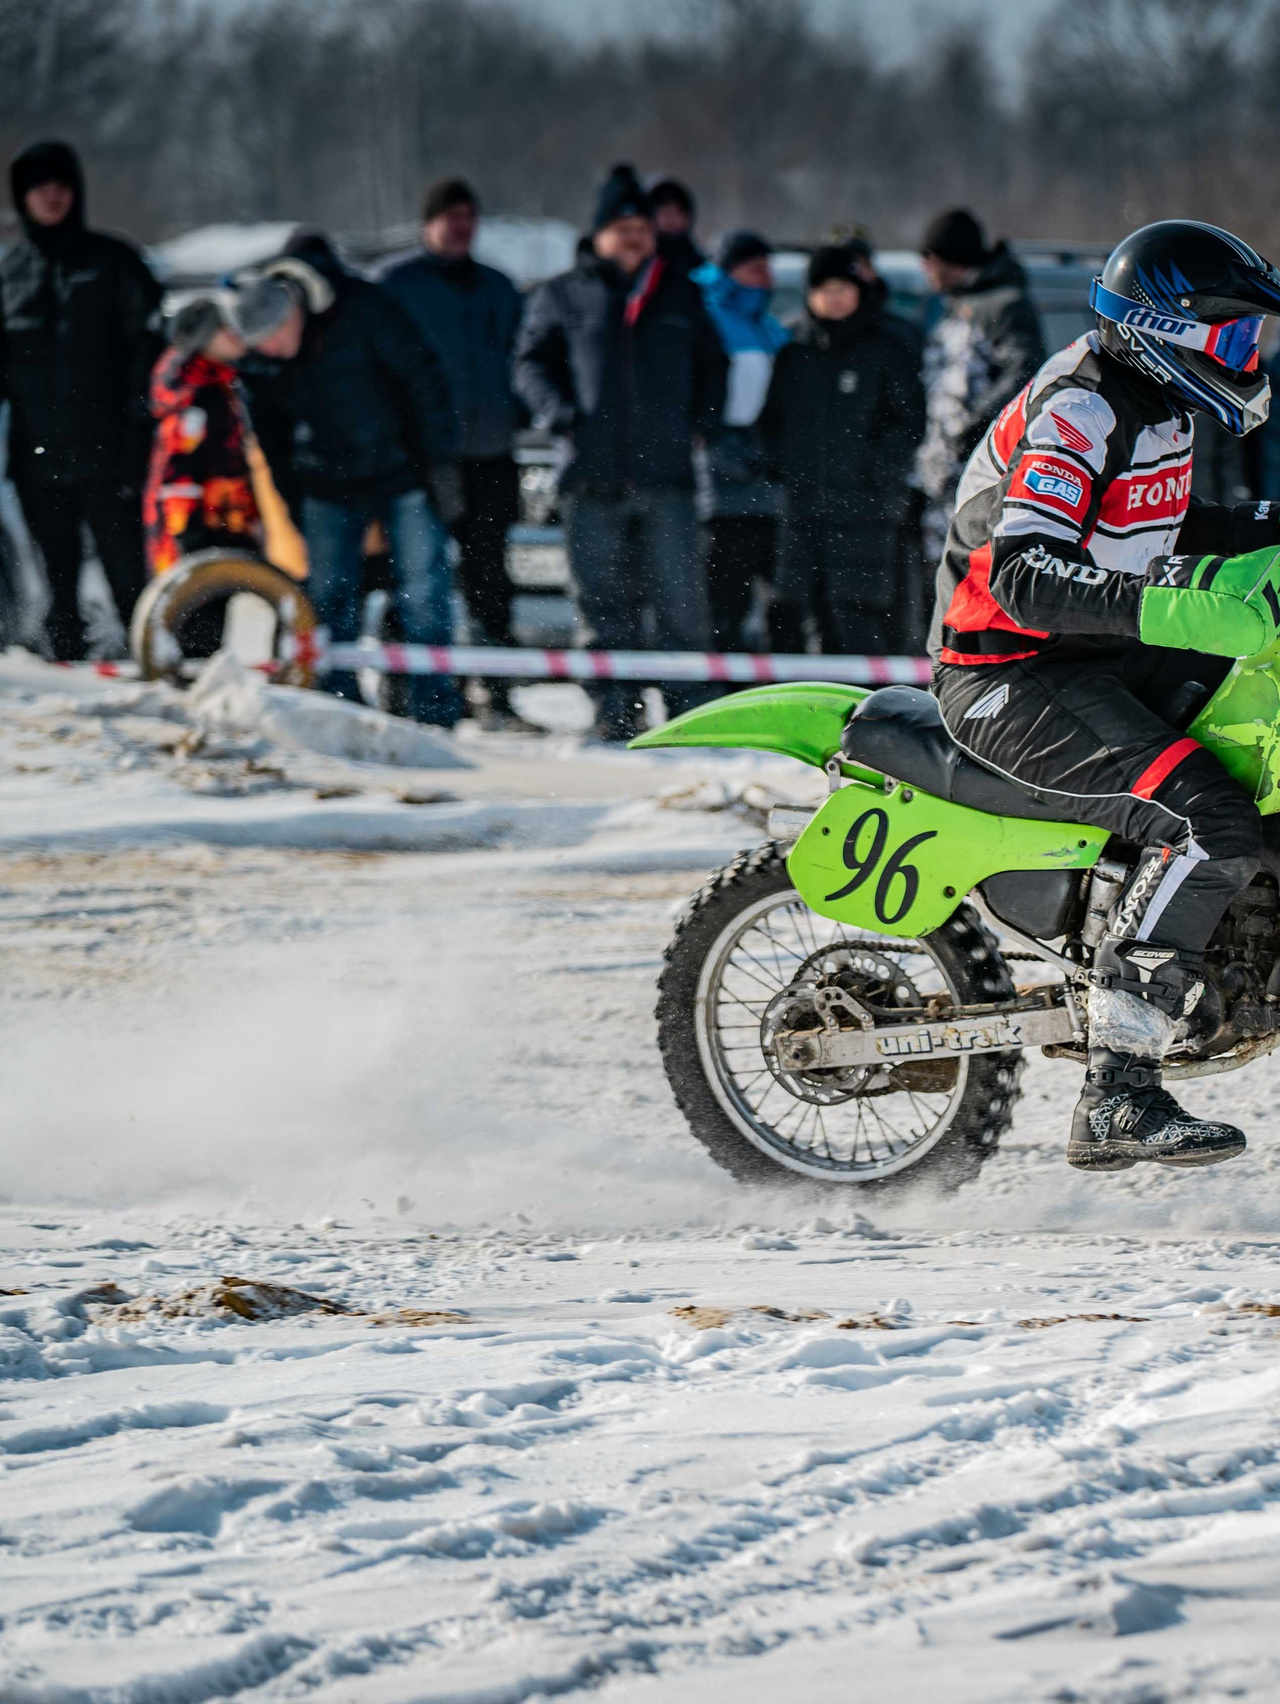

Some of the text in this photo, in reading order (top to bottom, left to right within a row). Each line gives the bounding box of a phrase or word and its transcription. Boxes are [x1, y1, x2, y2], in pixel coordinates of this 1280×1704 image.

[1124, 307, 1197, 336] thor
[1031, 461, 1083, 488] HONDA
[1037, 475, 1079, 500] GAS
[824, 807, 938, 925] 96
[876, 1021, 1022, 1055] uni-trak
